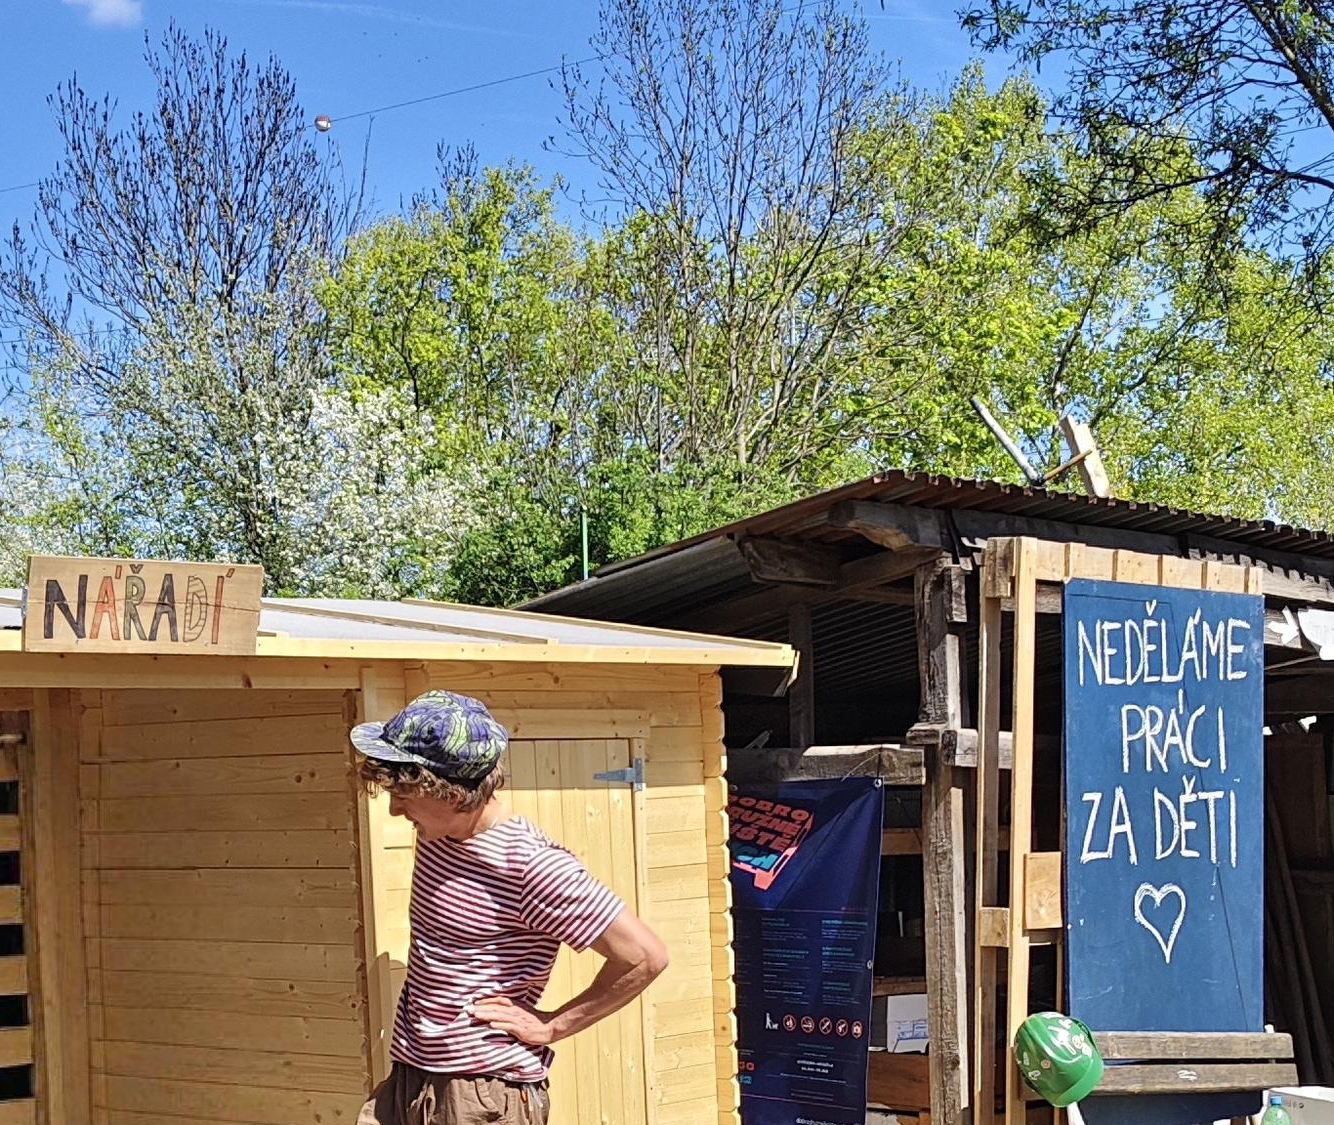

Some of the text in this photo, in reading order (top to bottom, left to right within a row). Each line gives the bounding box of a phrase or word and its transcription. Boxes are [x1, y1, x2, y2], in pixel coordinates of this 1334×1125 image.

[43, 563, 236, 645] NÁŘADÍ
[1077, 599, 1251, 687] NEDĚLÁME
[1120, 688, 1227, 774] PRÁCI
[1079, 774, 1238, 868] ZA DĚTI
